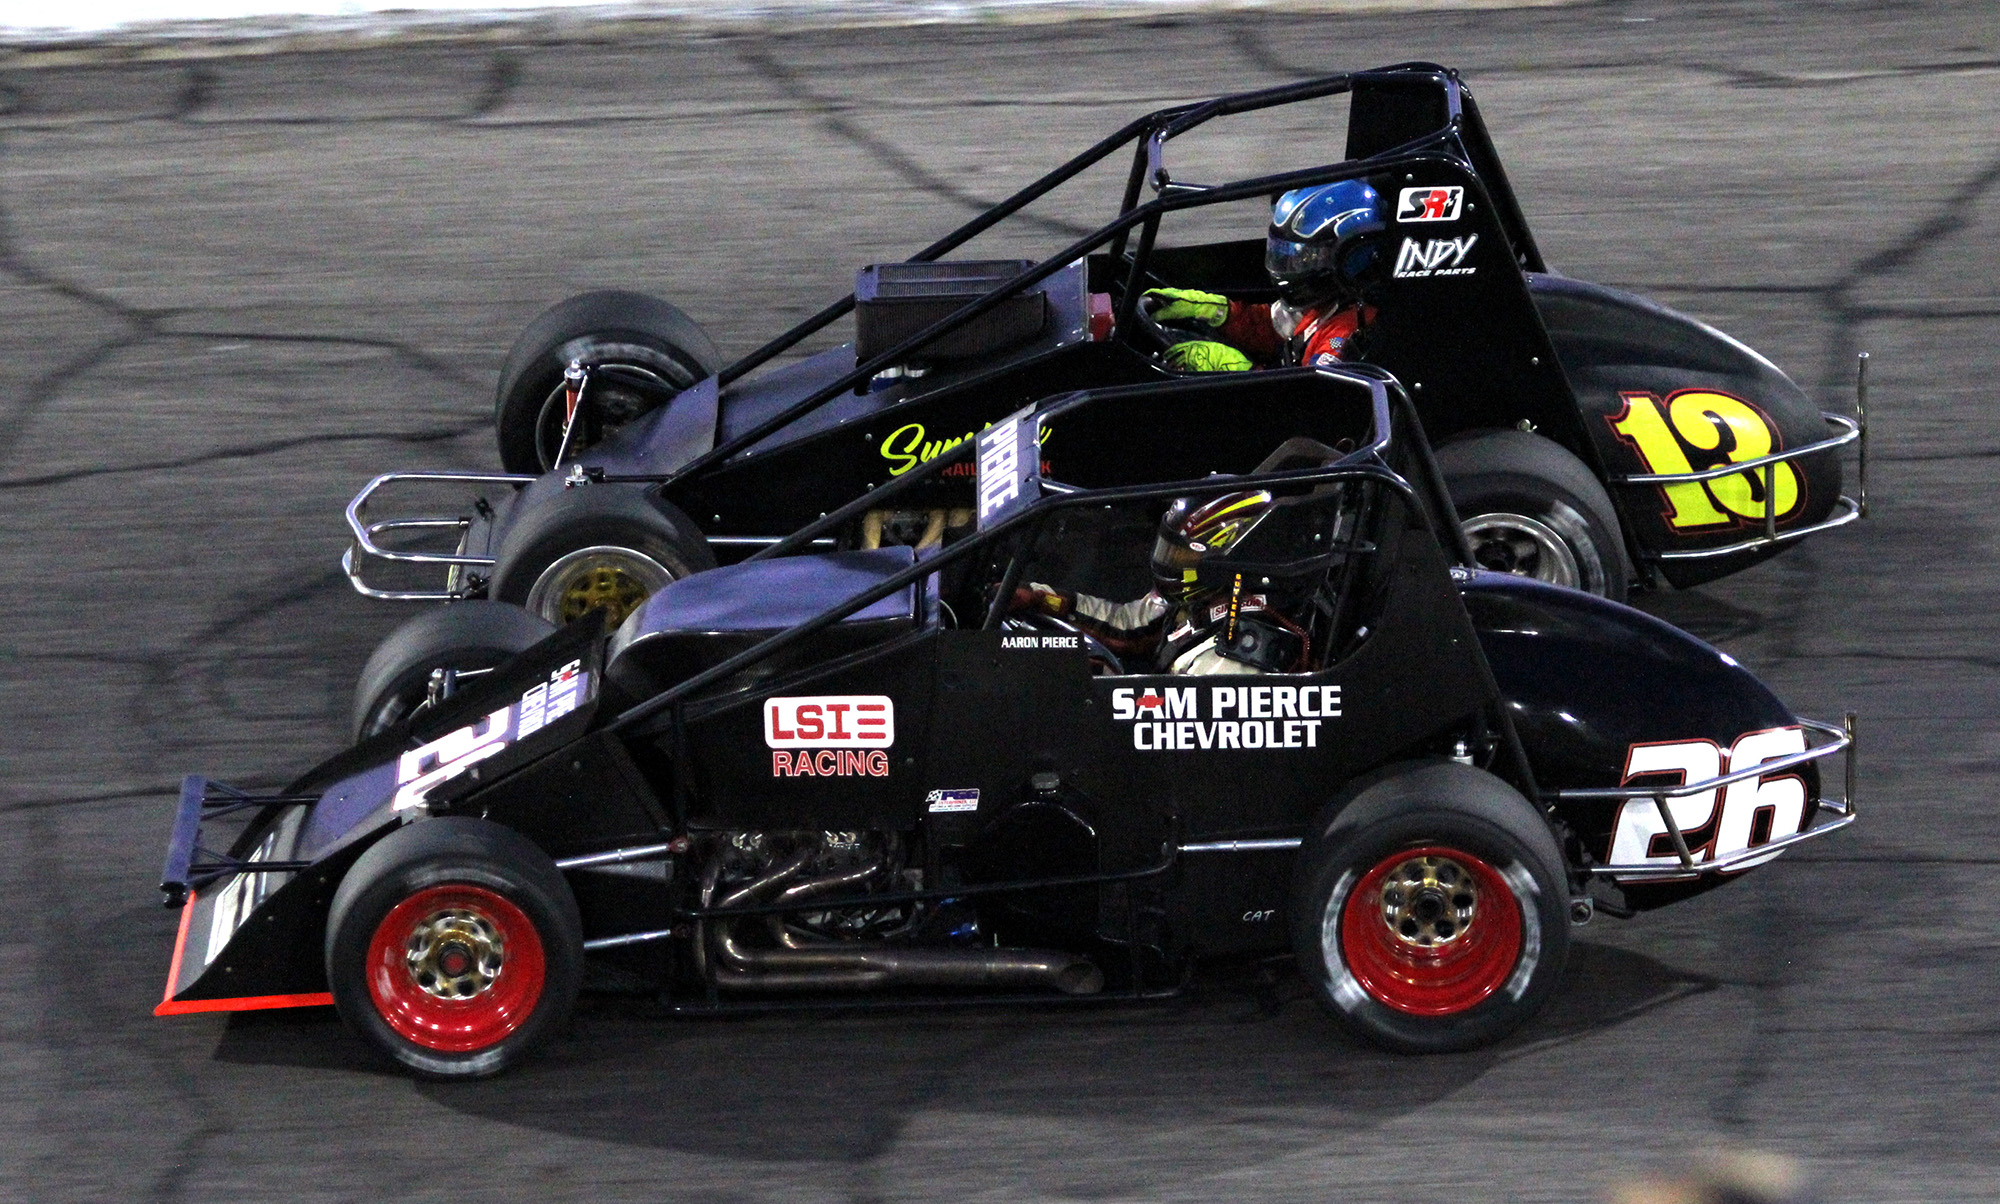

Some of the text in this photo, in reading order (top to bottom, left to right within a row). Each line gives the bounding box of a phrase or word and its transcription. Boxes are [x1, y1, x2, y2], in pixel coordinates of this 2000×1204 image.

[1393, 233, 1479, 278] INDY
[1397, 267, 1476, 278] RACE PARTS
[981, 418, 1018, 519] PIERCE
[1608, 390, 1804, 531] 13
[1001, 636, 1079, 649] AARON PIERCE
[1112, 685, 1342, 720] SAM PIERCE
[1133, 720, 1322, 750] CHEVROLET
[772, 750, 889, 777] RACING
[1605, 727, 1807, 884] 26
[1242, 909, 1275, 921] CAT
